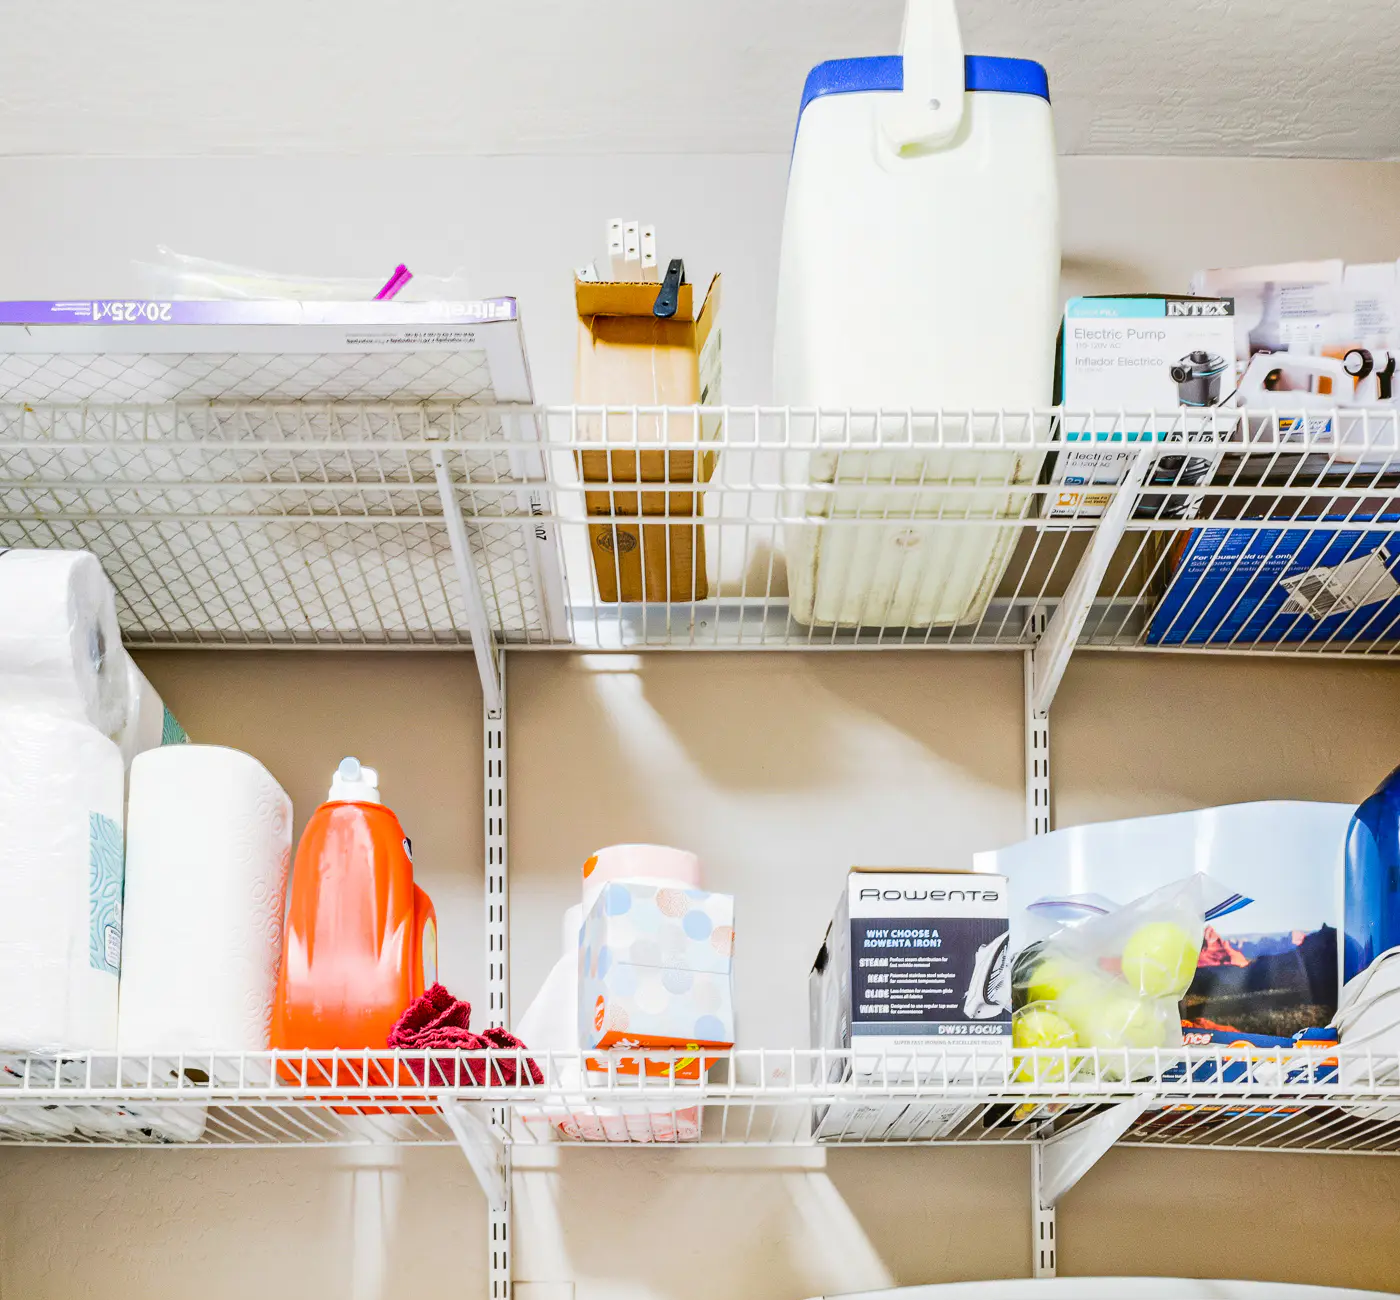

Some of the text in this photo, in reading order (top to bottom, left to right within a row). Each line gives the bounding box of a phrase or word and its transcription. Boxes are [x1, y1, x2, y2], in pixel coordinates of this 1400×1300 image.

[93, 302, 172, 321] 20x25x1
[1167, 301, 1230, 316] INTEX
[1074, 328, 1166, 344] Electric Pump
[1075, 356, 1114, 367] Inflador
[860, 888, 999, 902] Rowenta
[866, 930, 939, 938] WHY CHOOSE A
[864, 939, 942, 948] ROWENTA IRON?
[859, 958, 888, 968] STEAM
[868, 974, 889, 984] HEAT
[864, 989, 890, 998] GLIDE
[860, 1004, 890, 1014] WATER
[969, 1025, 1003, 1034] FOCUS
